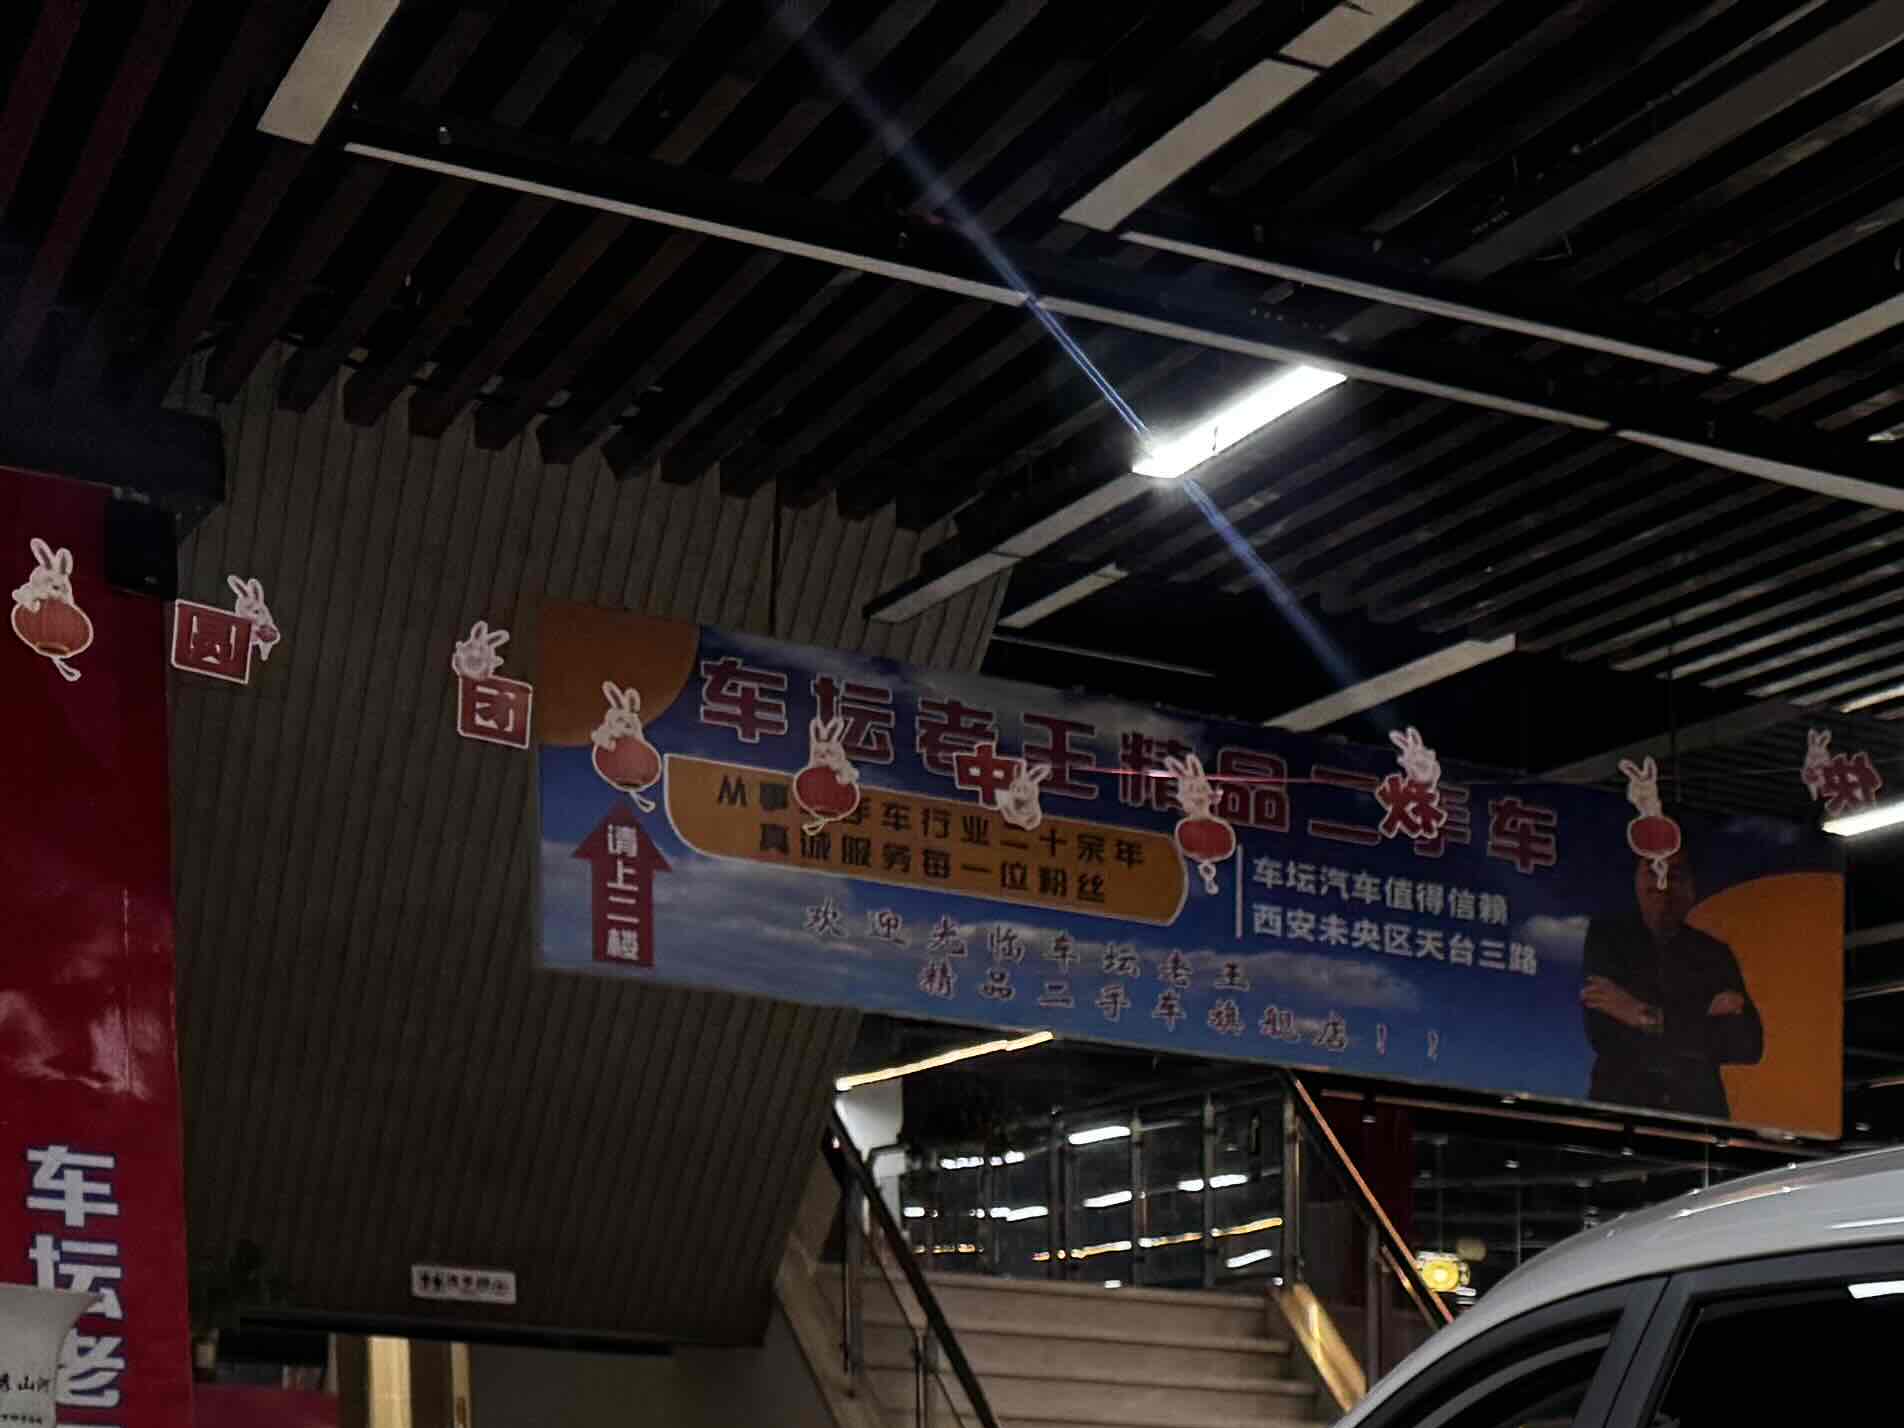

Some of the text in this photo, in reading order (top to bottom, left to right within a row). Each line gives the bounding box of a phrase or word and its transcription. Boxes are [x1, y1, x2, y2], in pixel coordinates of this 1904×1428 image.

[717, 775, 1145, 870] 从事手车行业二十余年
[1251, 856, 1509, 926] 车坛汽车值得信赖
[804, 897, 1251, 994] 欢迎光临车坛老王
[1251, 902, 1538, 977] 西安未央区天台三路
